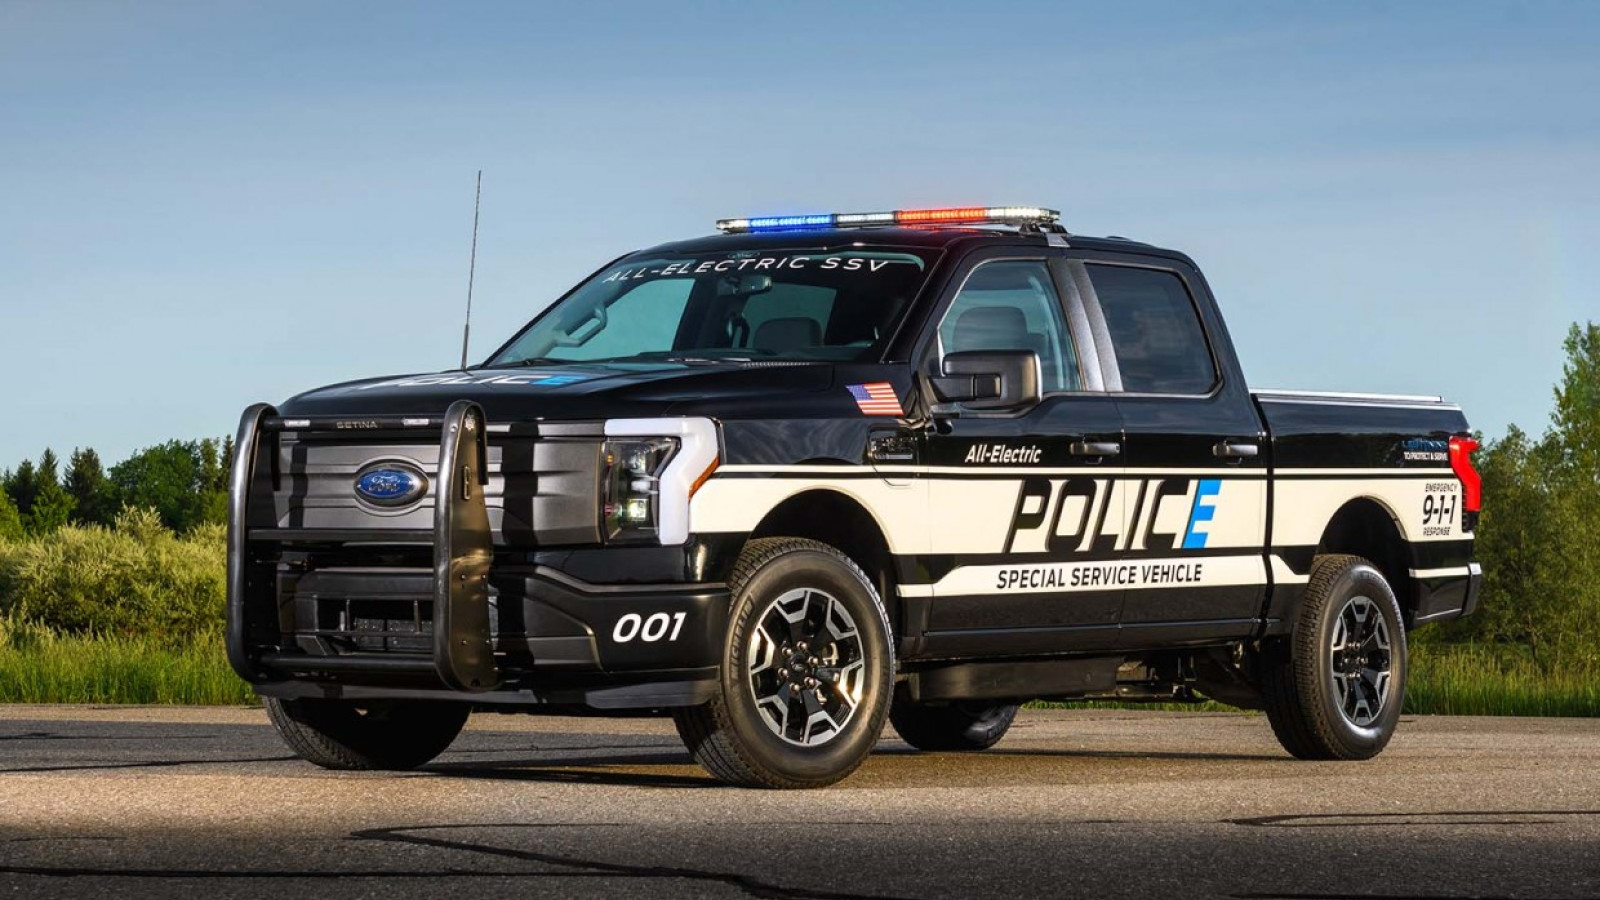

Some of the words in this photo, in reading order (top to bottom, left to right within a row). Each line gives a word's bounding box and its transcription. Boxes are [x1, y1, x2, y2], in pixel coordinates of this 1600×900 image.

[602, 257, 811, 283] ALL-ELECTRIC
[820, 257, 889, 273] SSV
[336, 420, 378, 429] SETINA
[965, 445, 1042, 463] All-Electric
[1002, 478, 1223, 553] POLICE
[1422, 494, 1457, 524] 9-1-1
[996, 567, 1066, 589] SPECIAL
[1070, 564, 1138, 587] SERVICE
[1141, 562, 1203, 584] VEHICLE
[613, 612, 686, 642] 001
